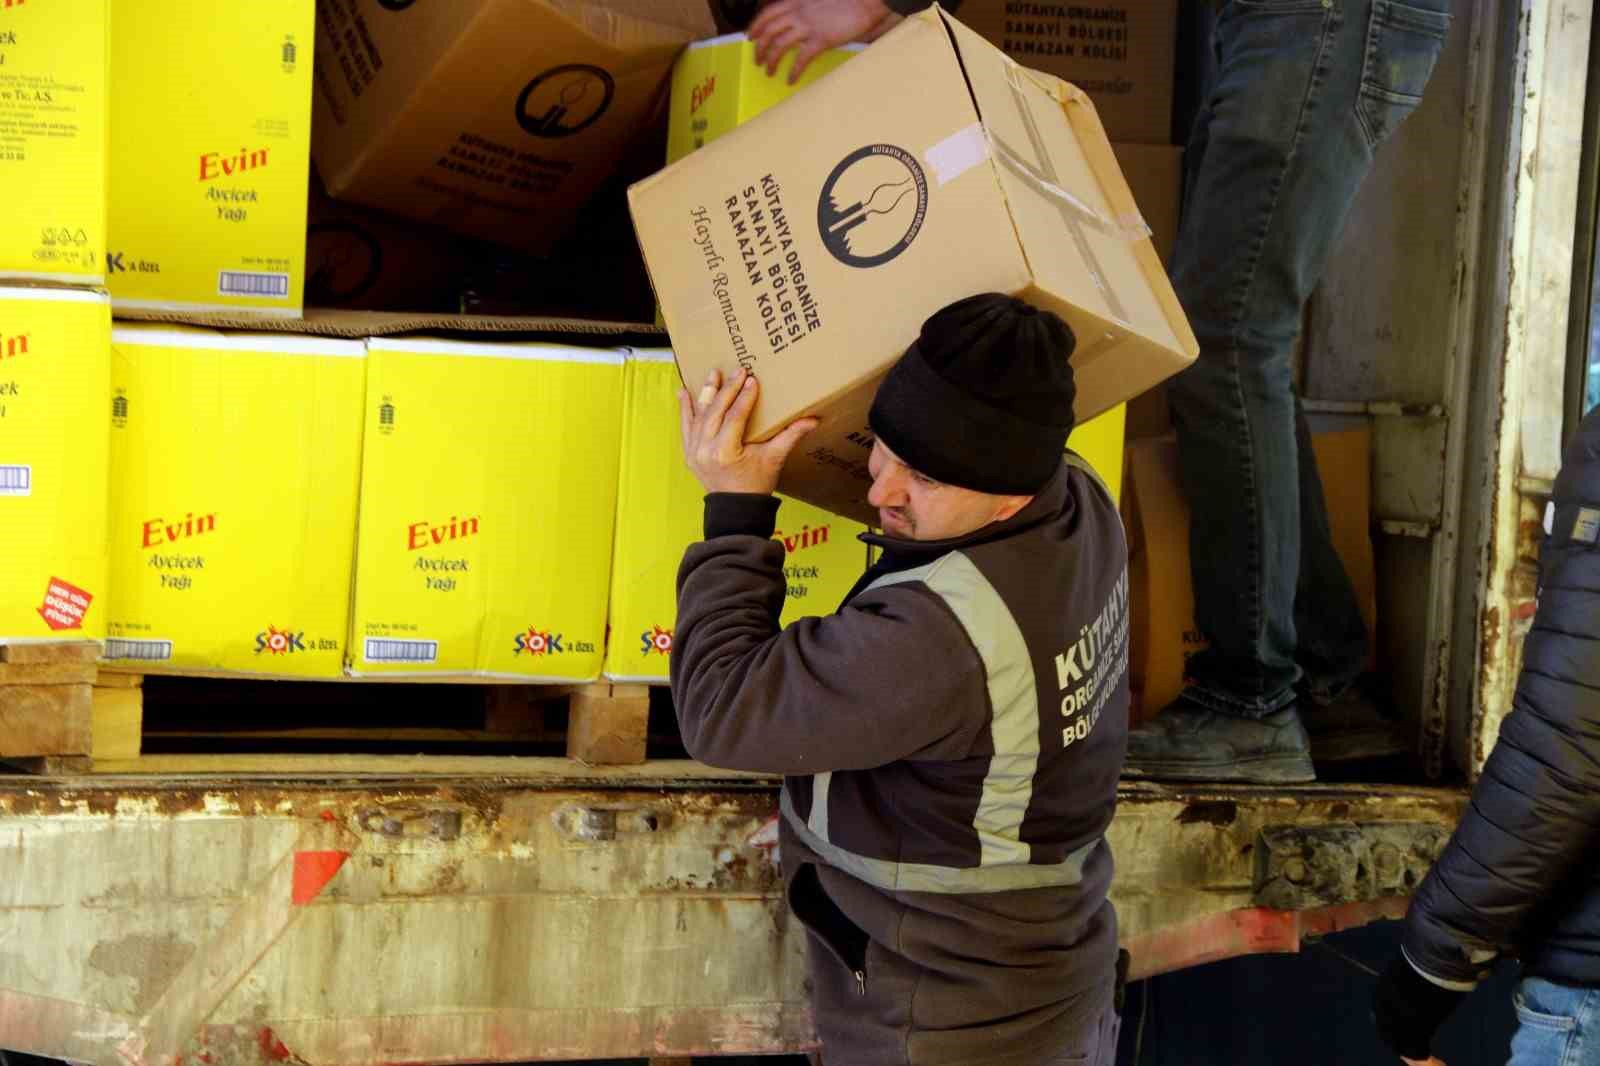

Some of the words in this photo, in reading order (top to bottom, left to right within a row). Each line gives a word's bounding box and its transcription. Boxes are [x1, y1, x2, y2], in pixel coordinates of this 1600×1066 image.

[199, 148, 269, 181] Evin
[690, 206, 725, 271] Hayırlı
[760, 174, 795, 250] KÜTAHYA
[785, 250, 821, 332] ORGANİZE
[725, 195, 763, 286] RAMAZAN
[756, 292, 790, 354] KOLİSİ
[743, 186, 778, 256] SANAYİ
[768, 263, 806, 344] BÖLGESİ
[142, 512, 217, 549] Evin
[407, 515, 480, 551] Evin
[776, 524, 830, 553] vin
[641, 625, 673, 656] ŞO
